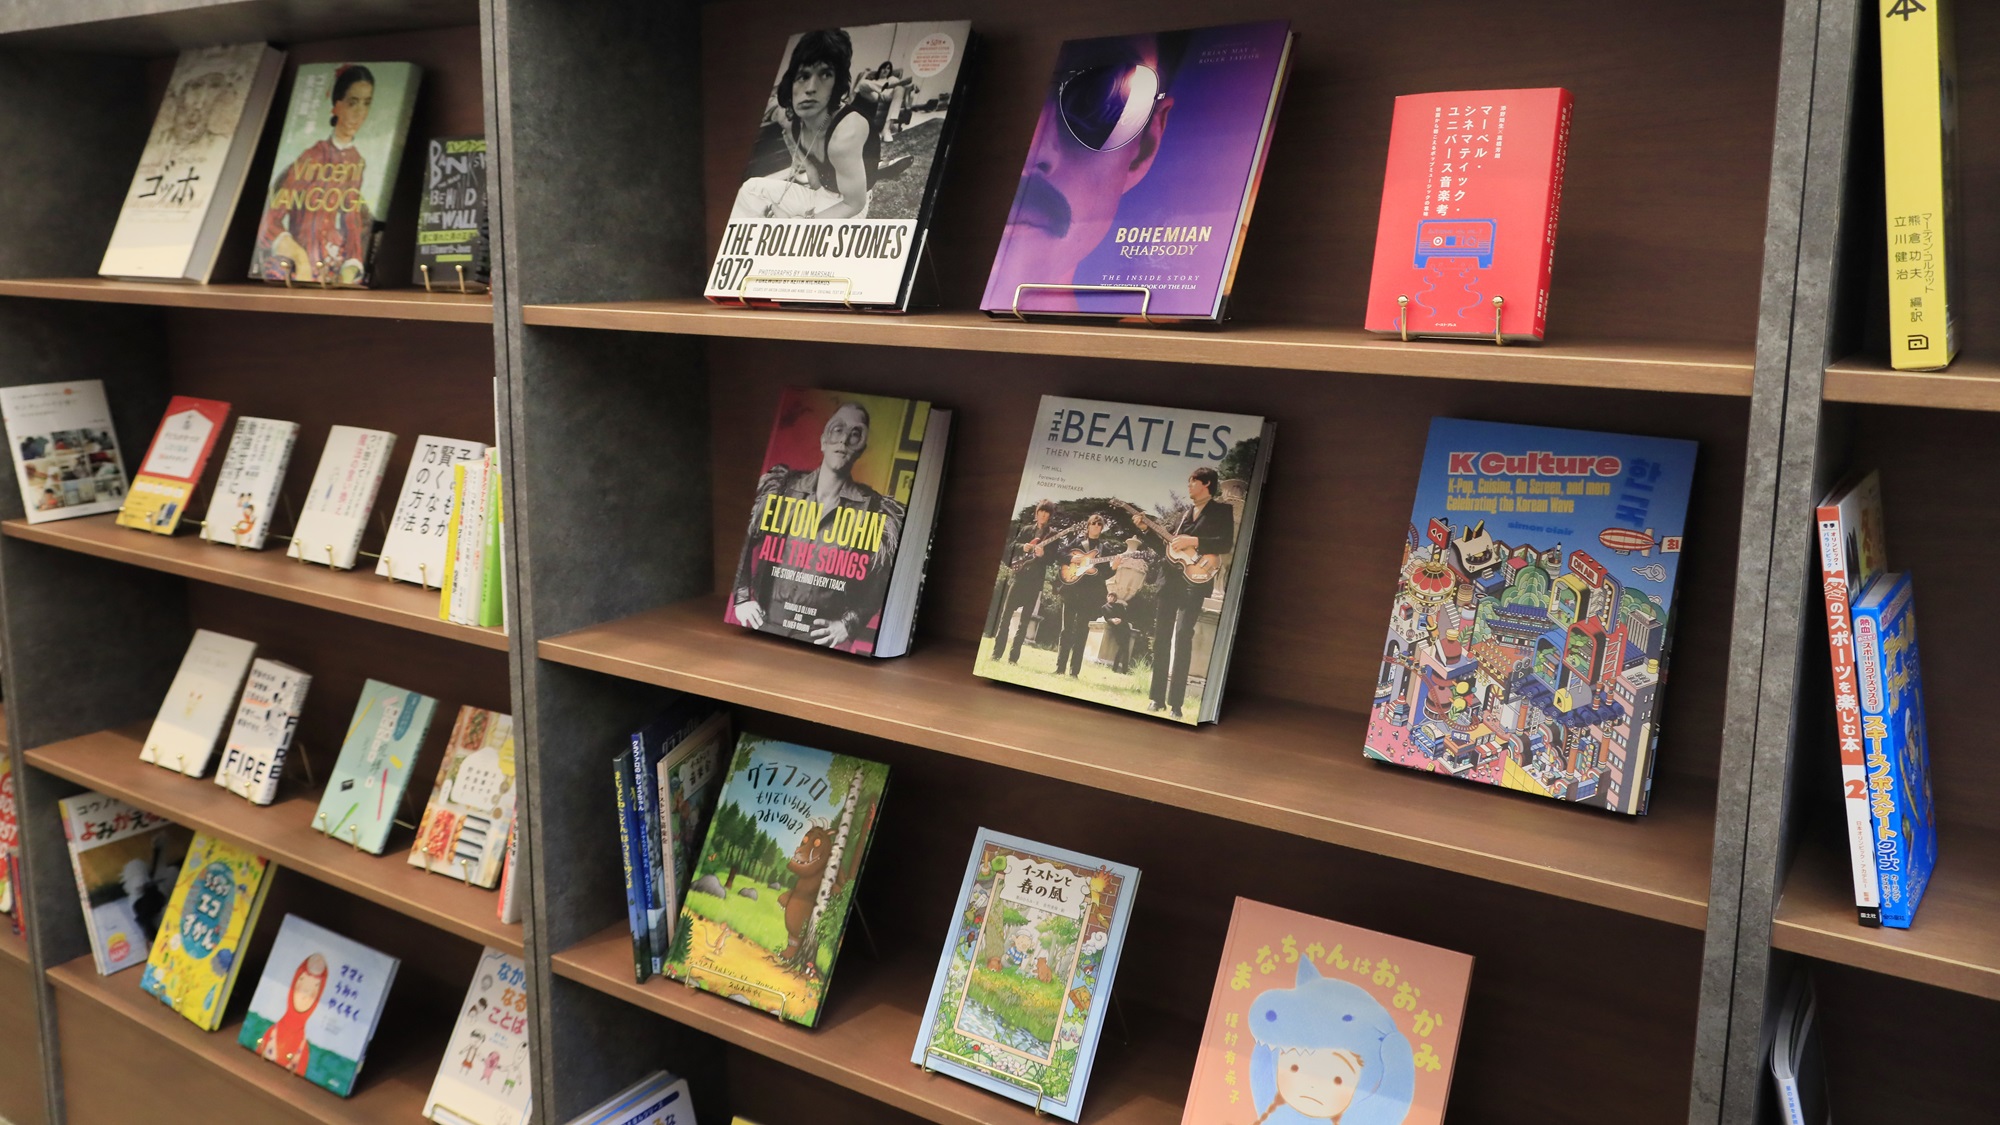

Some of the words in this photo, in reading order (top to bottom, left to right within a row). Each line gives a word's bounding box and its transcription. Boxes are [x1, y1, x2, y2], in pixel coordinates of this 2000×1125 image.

[293, 159, 365, 183] Vincent
[1435, 107, 1460, 216] ユニバース音楽考
[1454, 106, 1477, 212] シネマティック・
[139, 160, 200, 206] ゴッホ
[441, 208, 478, 230] WALL
[722, 224, 758, 256] THE
[754, 224, 834, 258] ROLLING
[832, 224, 908, 260] STONES
[1115, 226, 1212, 243] BOHEMIAN
[1894, 215, 1908, 280] 立川健治
[1908, 214, 1922, 280] 熊倉功夫
[1120, 244, 1198, 258] RHAPSODY
[710, 258, 755, 291] 1972
[1910, 297, 1923, 322] 編・訳
[1048, 408, 1064, 442] THE
[1061, 409, 1232, 461] BEATLES
[1045, 447, 1070, 458] THEN
[1072, 450, 1101, 462] THERE
[1104, 454, 1124, 464] WAS
[1127, 456, 1158, 469] MUSIC
[1448, 452, 1478, 475] K
[1478, 452, 1622, 477] Culture
[1448, 478, 1476, 495] K-Pop,
[1478, 478, 1514, 495] Cuisine,
[1516, 478, 1528, 494] On
[1529, 480, 1564, 496] Screen,
[1566, 480, 1584, 495] and
[1585, 481, 1610, 496] more
[1446, 495, 1498, 514] Celebrating
[1500, 496, 1514, 512] the
[1516, 496, 1548, 512] Korean
[1550, 498, 1575, 513] Wave
[760, 494, 824, 540] ELTON
[824, 506, 887, 553] JOHN
[759, 534, 786, 565] ALL
[787, 540, 814, 571] THE
[815, 547, 870, 581] SONGS
[1824, 532, 1832, 568] パラリンピック
[771, 566, 781, 578] THE
[780, 568, 797, 581] STORY
[795, 571, 815, 585] BEHIND
[813, 575, 829, 588] EVERY
[828, 578, 847, 592] TRACK
[1574, 559, 1584, 572] ON
[1584, 567, 1594, 582] AIR
[1824, 578, 1860, 752] 冬のスポーツを楽しむ本
[268, 716, 300, 780] FIRE
[225, 749, 266, 784] FIRE
[748, 762, 828, 801] グラファロ
[1844, 779, 1867, 800] 2
[1018, 878, 1068, 903] 春の風
[1023, 864, 1072, 888] イーストンと
[198, 894, 222, 918] エコ
[341, 964, 365, 983] ママと
[501, 987, 527, 1013] なる
[1230, 934, 1443, 1072] まなちゃんはおおかみ
[488, 1006, 529, 1035] ことば
[1224, 1012, 1240, 1104] 種村有希子
